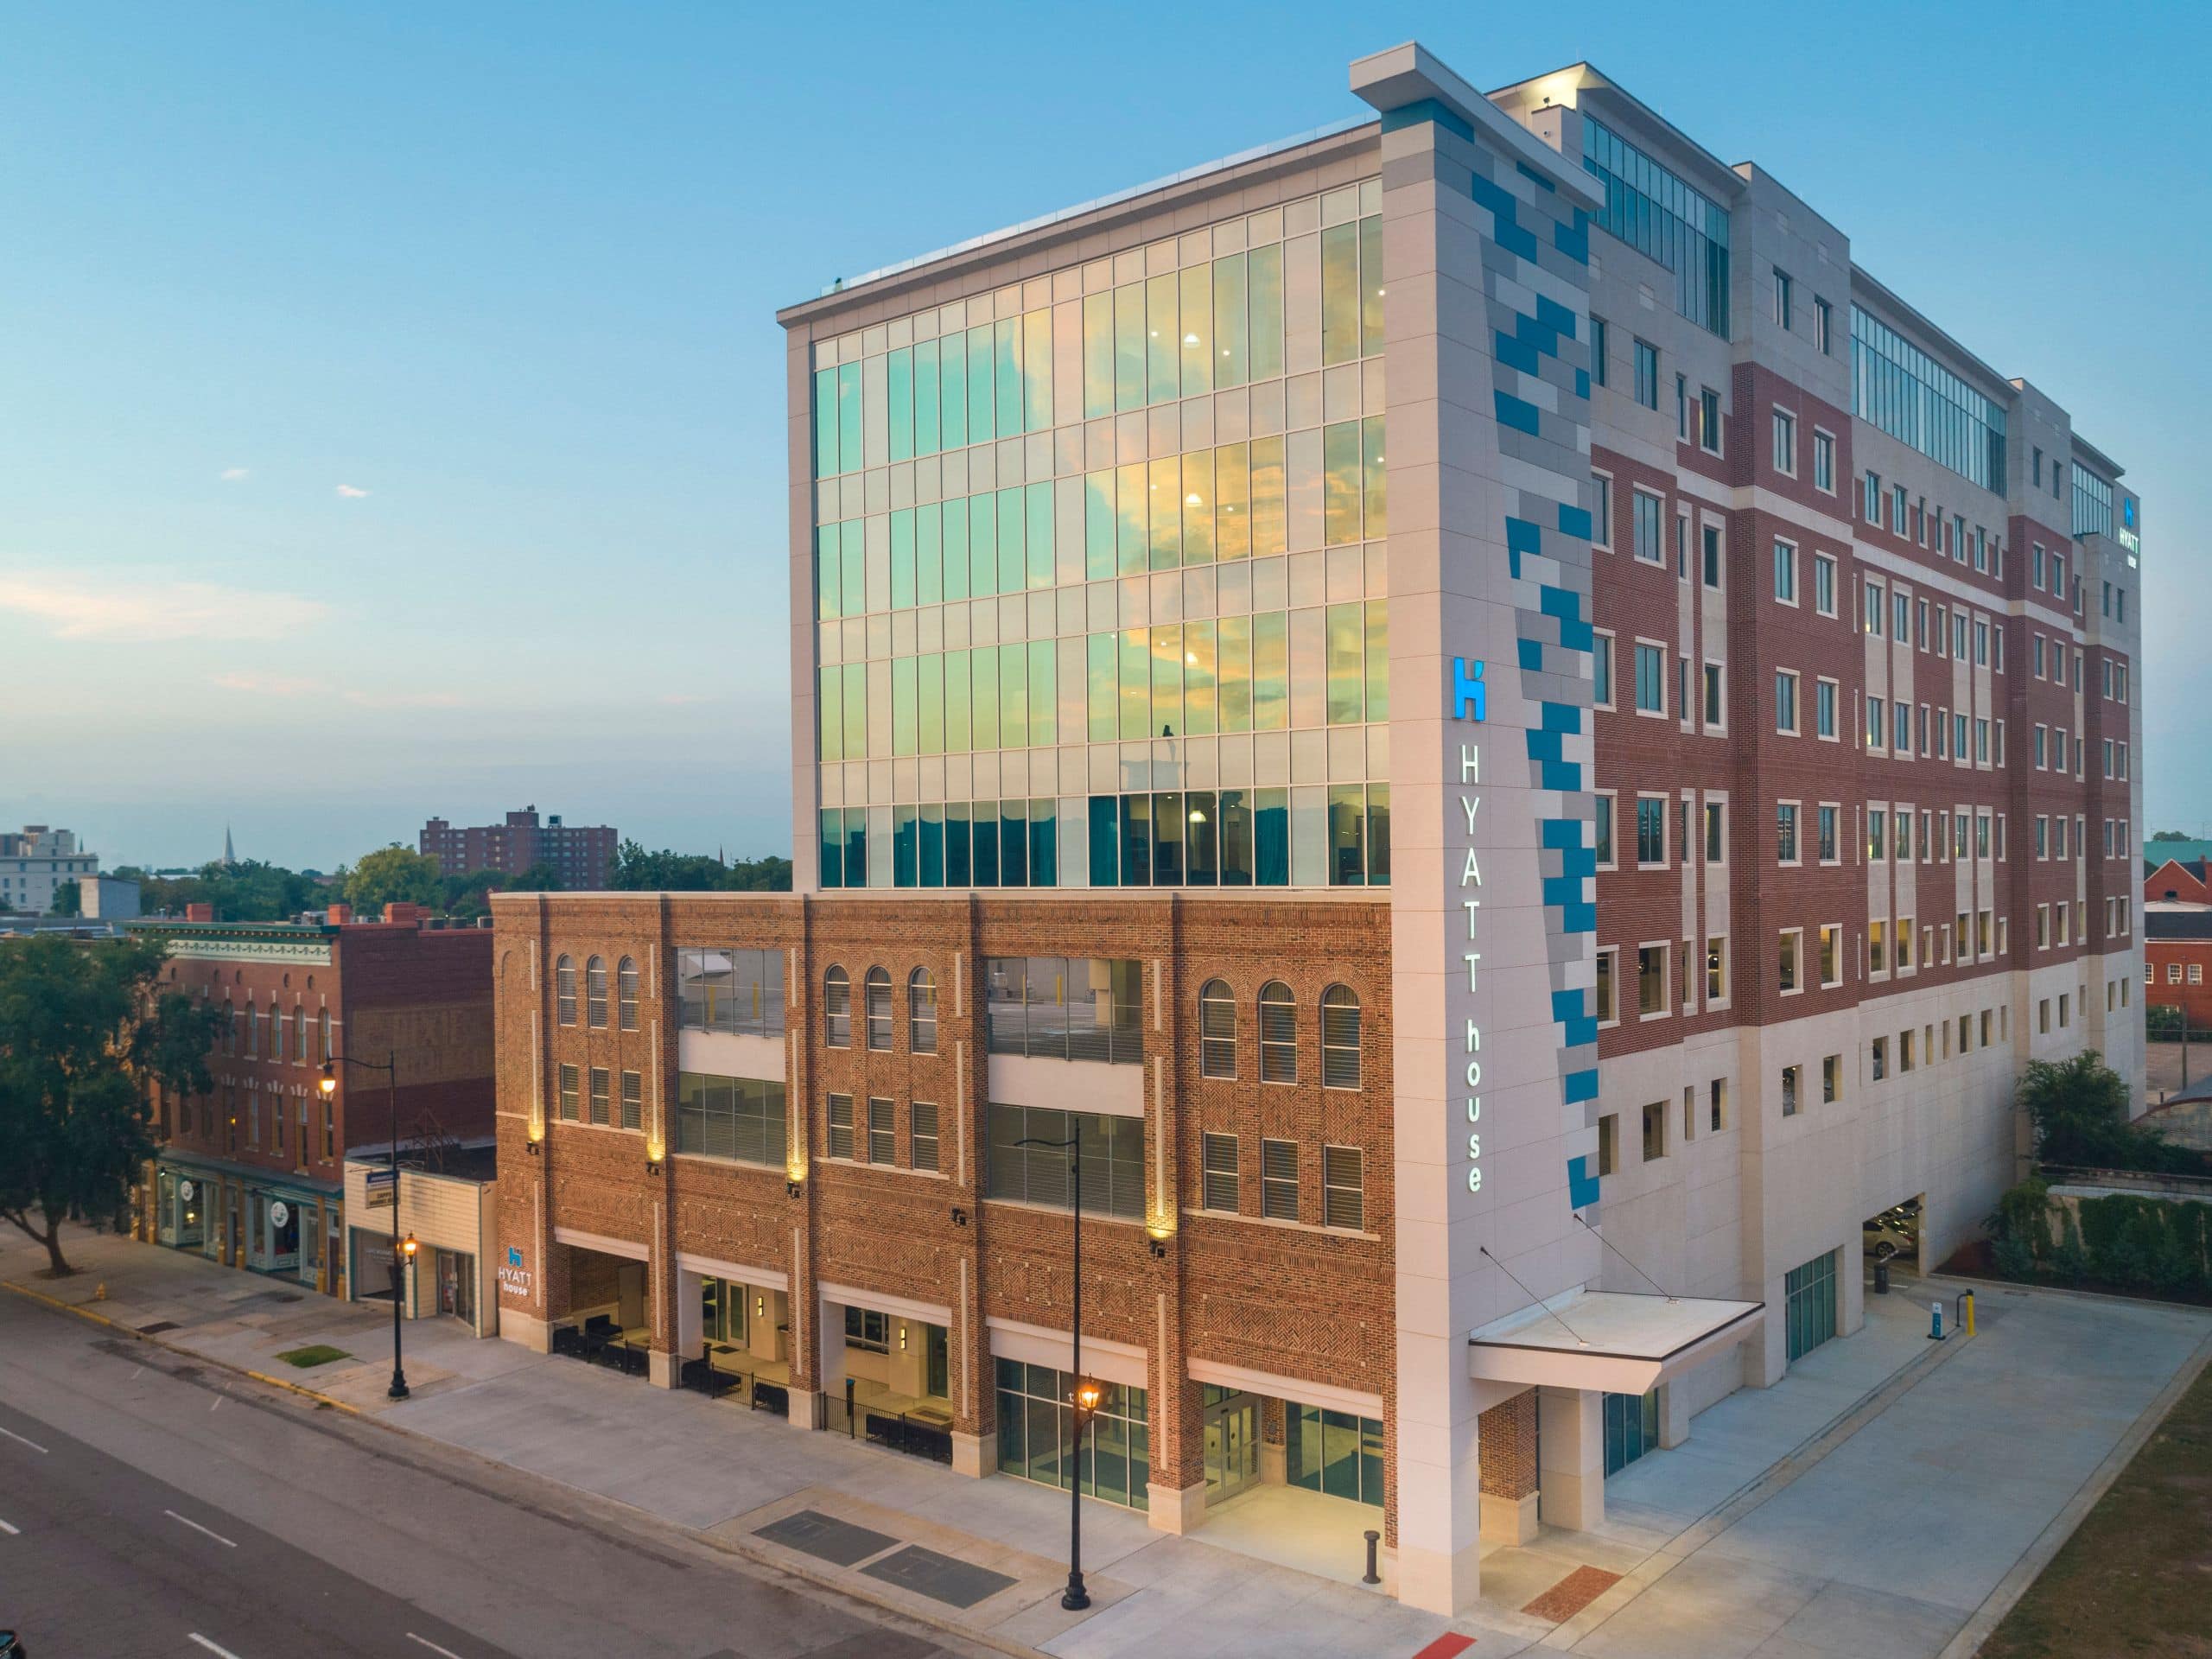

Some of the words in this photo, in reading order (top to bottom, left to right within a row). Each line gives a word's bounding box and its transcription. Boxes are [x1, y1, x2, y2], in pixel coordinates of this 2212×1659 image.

[2120, 527, 2139, 554] HYATT
[1459, 744, 1483, 993] HYATT
[1466, 1018, 1483, 1193] house
[498, 1266, 532, 1287] HYATT
[504, 1281, 529, 1296] house
